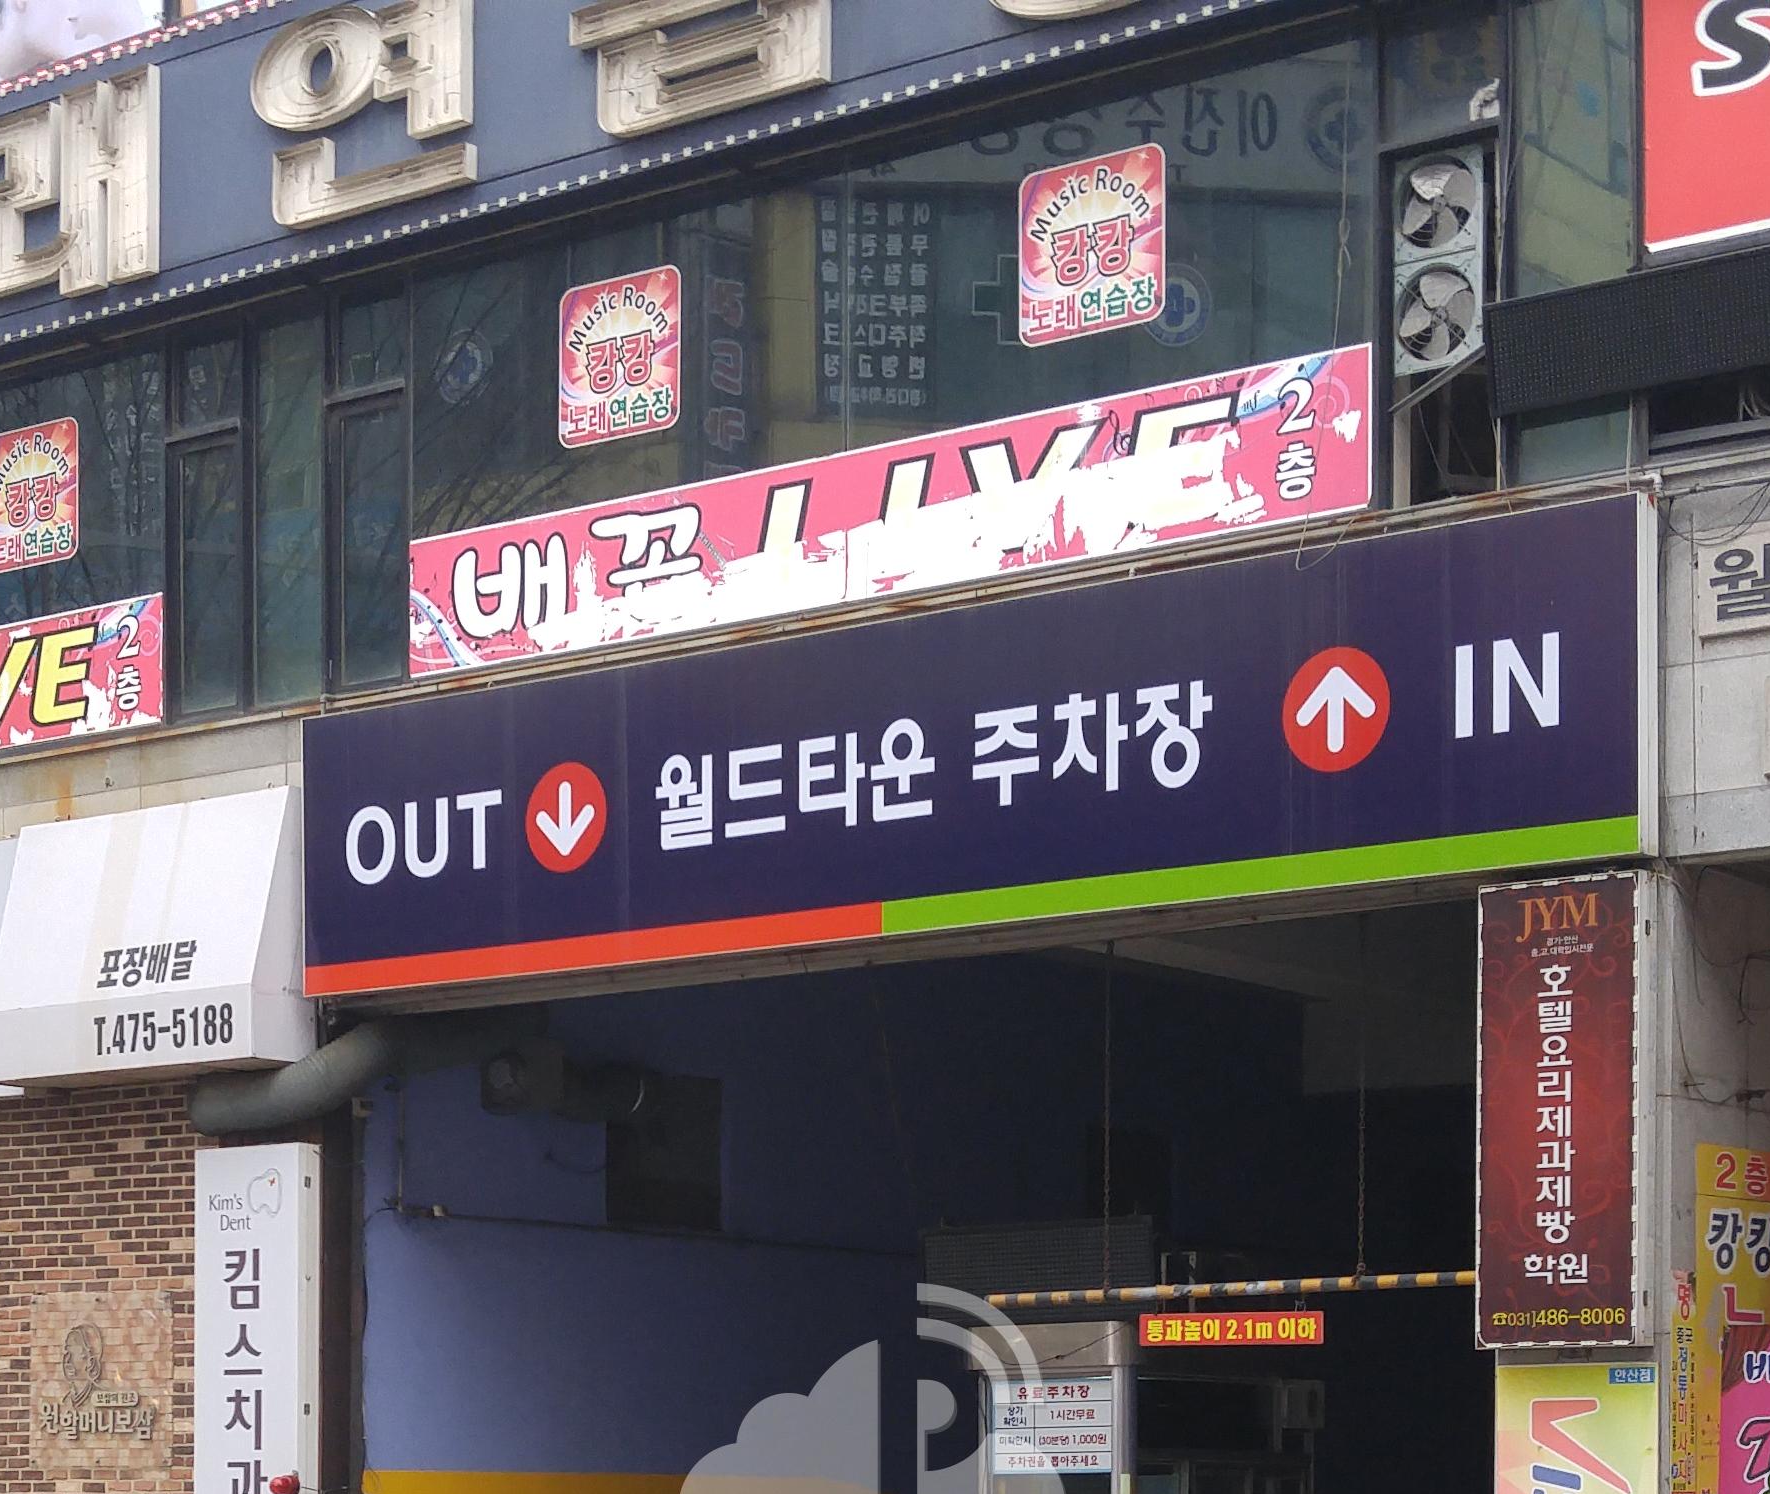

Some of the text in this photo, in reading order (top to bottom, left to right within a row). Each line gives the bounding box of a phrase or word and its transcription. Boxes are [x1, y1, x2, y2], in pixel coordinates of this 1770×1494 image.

[1030, 166, 1152, 243] Music Room
[1052, 214, 1136, 288] 캉캉
[568, 285, 671, 354] Music Room
[1028, 275, 1157, 336] 노래연습장
[585, 329, 654, 395] 캉캉
[565, 386, 675, 437] 노래연습장
[32, 432, 71, 476] Room
[1274, 378, 1318, 500] 2층
[6, 475, 57, 529] 캉캉
[345, 631, 1561, 887] OUT 월드타운 주차장 IN
[1515, 894, 1599, 943] JYM
[97, 940, 198, 989] 포장배달
[93, 1004, 233, 1057] T.475-5188
[1716, 1152, 1769, 1197] 2층
[208, 1193, 243, 1212] Kim's
[219, 1213, 252, 1231] Dent
[1524, 1252, 1589, 1287] 학원
[1146, 1317, 1317, 1343] 통과높이 2.1m 이하
[1017, 1385, 1091, 1401] 유료주차장
[1614, 1367, 1656, 1384] 안산점
[39, 1402, 157, 1440] 원할머니보쌈
[1049, 1408, 1096, 1422] 1시간무료
[1050, 1454, 1100, 1468] 뽑아주세요
[1071, 1433, 1108, 1446] 1,000원
